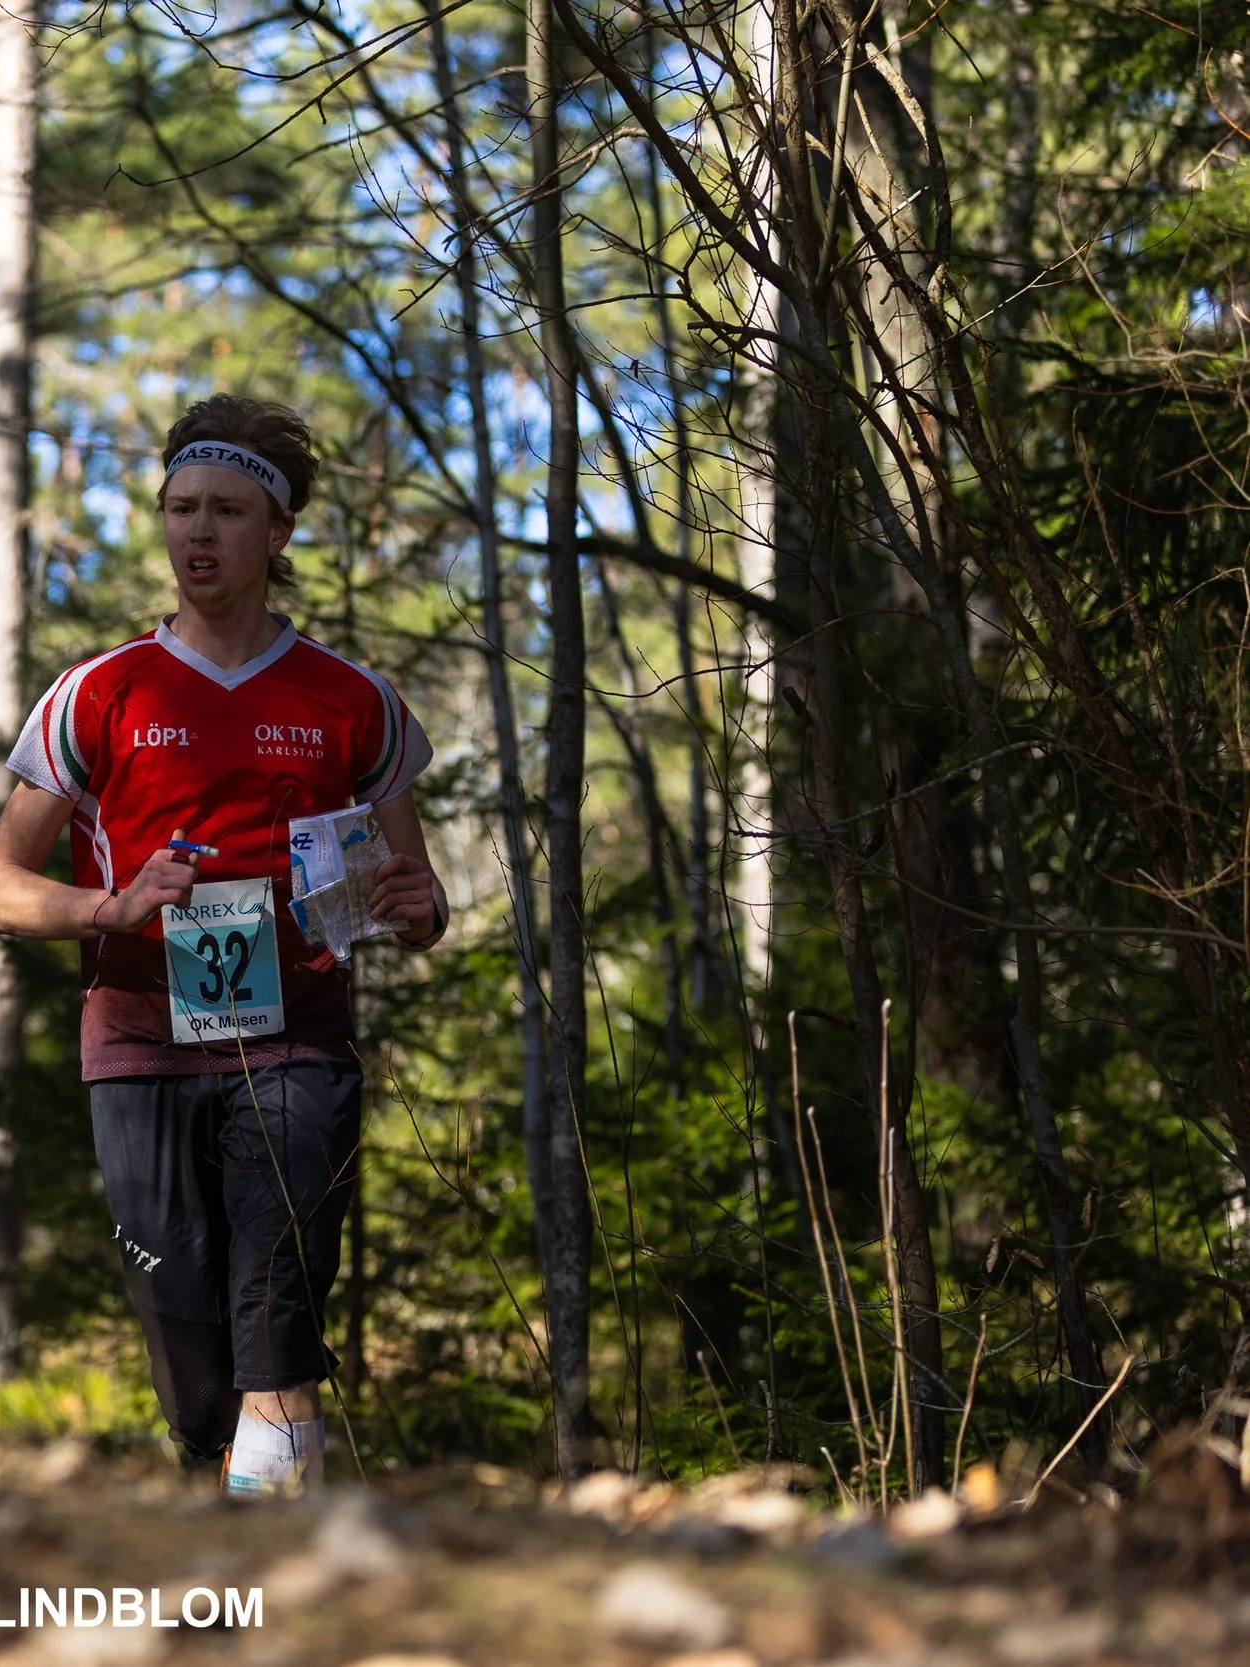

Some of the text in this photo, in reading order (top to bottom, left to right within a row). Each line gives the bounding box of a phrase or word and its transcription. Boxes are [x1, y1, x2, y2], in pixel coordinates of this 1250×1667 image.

[133, 723, 189, 747] LÖP1
[254, 724, 323, 745] OK TYR
[257, 746, 324, 758] KARLSTAD
[171, 903, 235, 922] NOREX
[196, 930, 253, 1003] 32
[190, 1017, 214, 1032] OK
